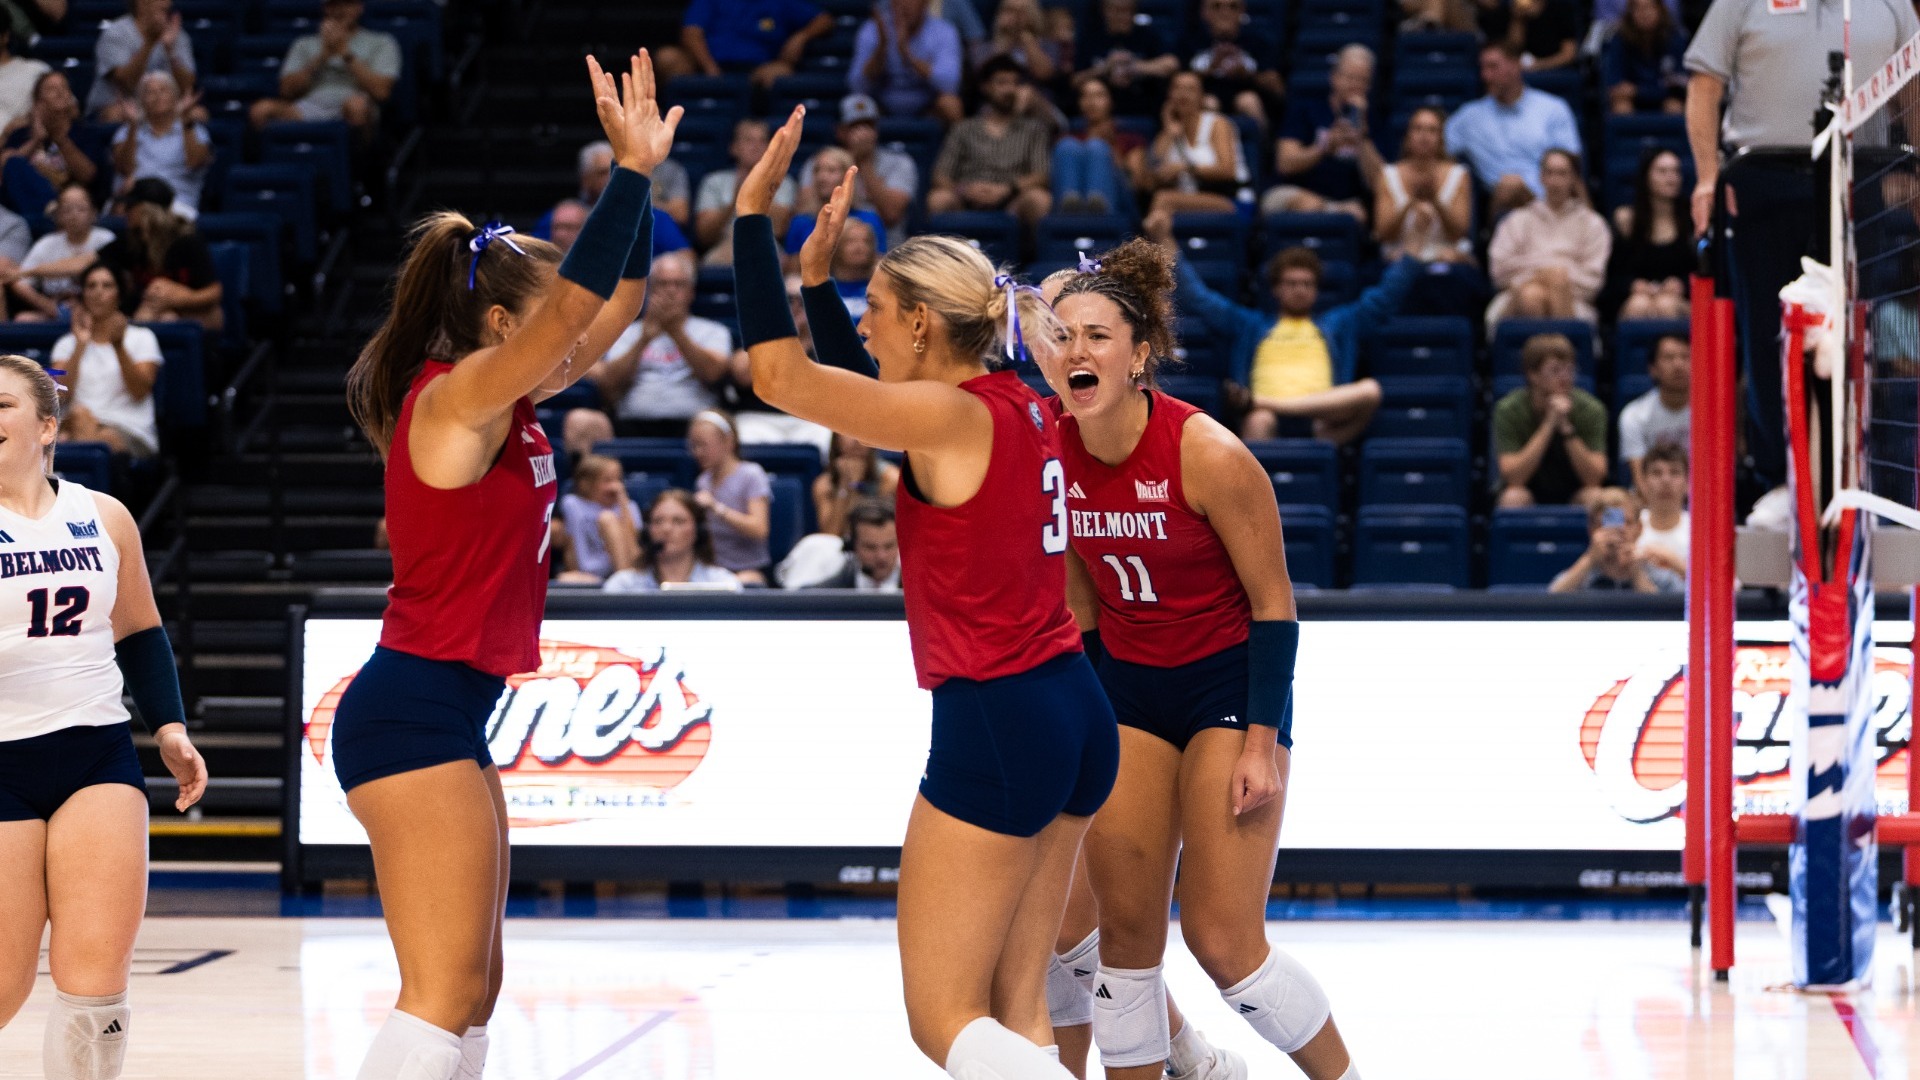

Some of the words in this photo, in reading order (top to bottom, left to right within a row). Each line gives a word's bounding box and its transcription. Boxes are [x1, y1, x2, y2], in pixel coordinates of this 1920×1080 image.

[1135, 479, 1168, 499] VALLEY
[1042, 457, 1068, 556] 3
[66, 519, 98, 537] VALLEY
[1071, 509, 1168, 540] BELMONT
[0, 546, 103, 579] BELMONT
[1102, 554, 1158, 602] 11
[27, 586, 90, 638] 12
